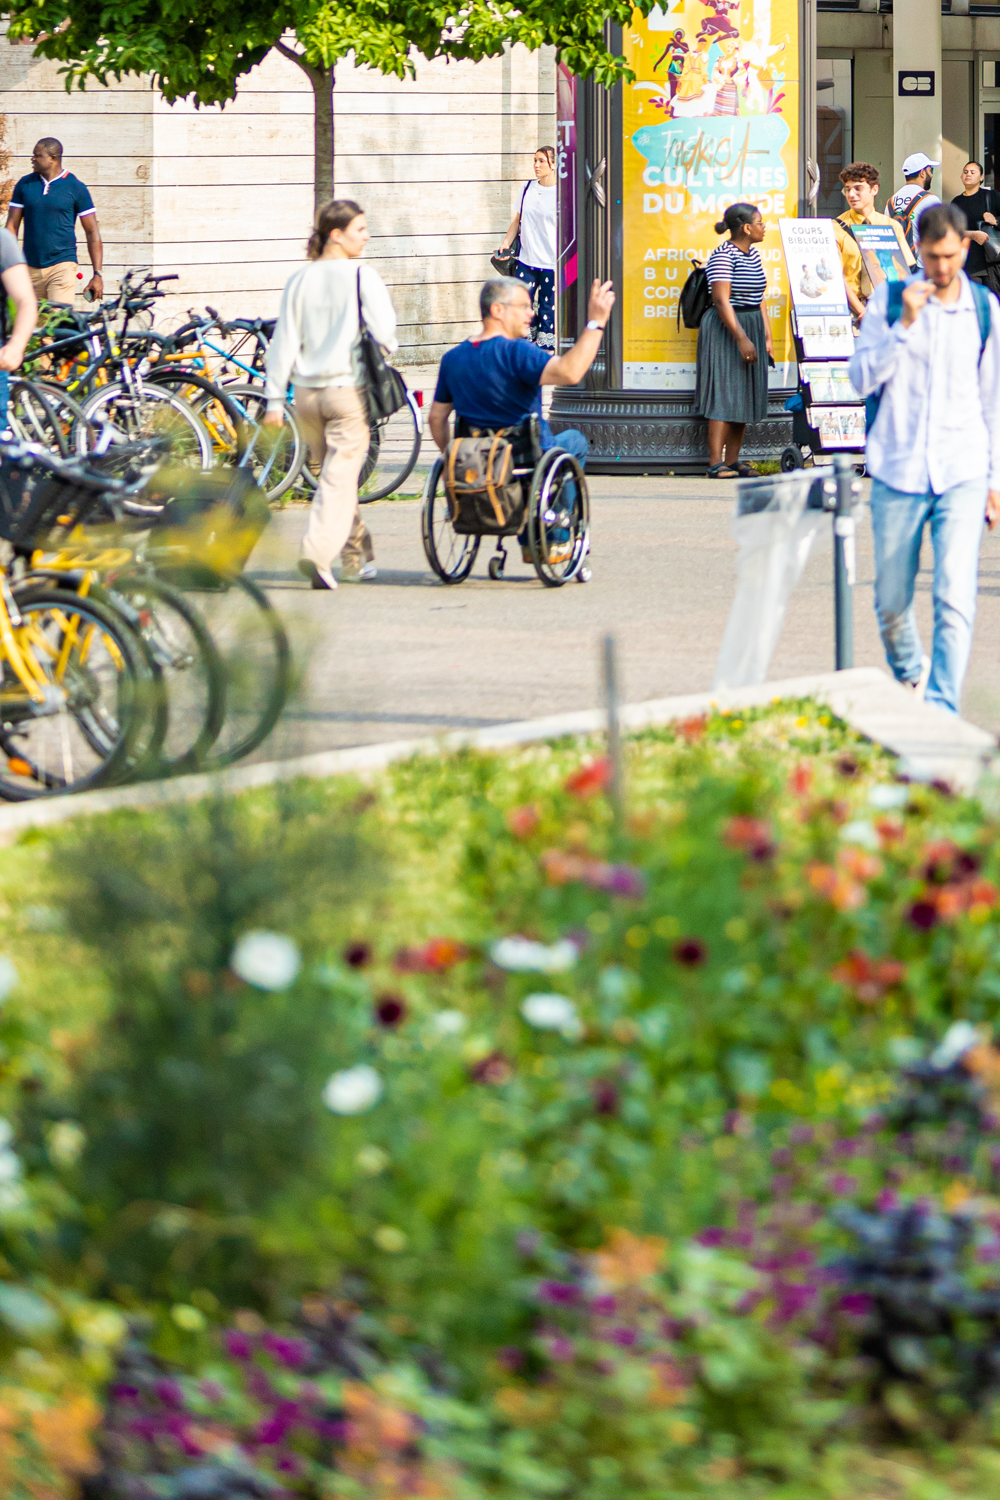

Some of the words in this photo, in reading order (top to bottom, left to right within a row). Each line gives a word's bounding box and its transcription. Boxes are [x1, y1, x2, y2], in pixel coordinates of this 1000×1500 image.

[642, 165, 786, 188] CULTURES
[643, 193, 684, 214] DU
[692, 193, 786, 215] MONDE
[791, 226, 823, 235] COURS
[788, 236, 831, 245] BIBLIQUE
[643, 248, 711, 262] AFRIQU
